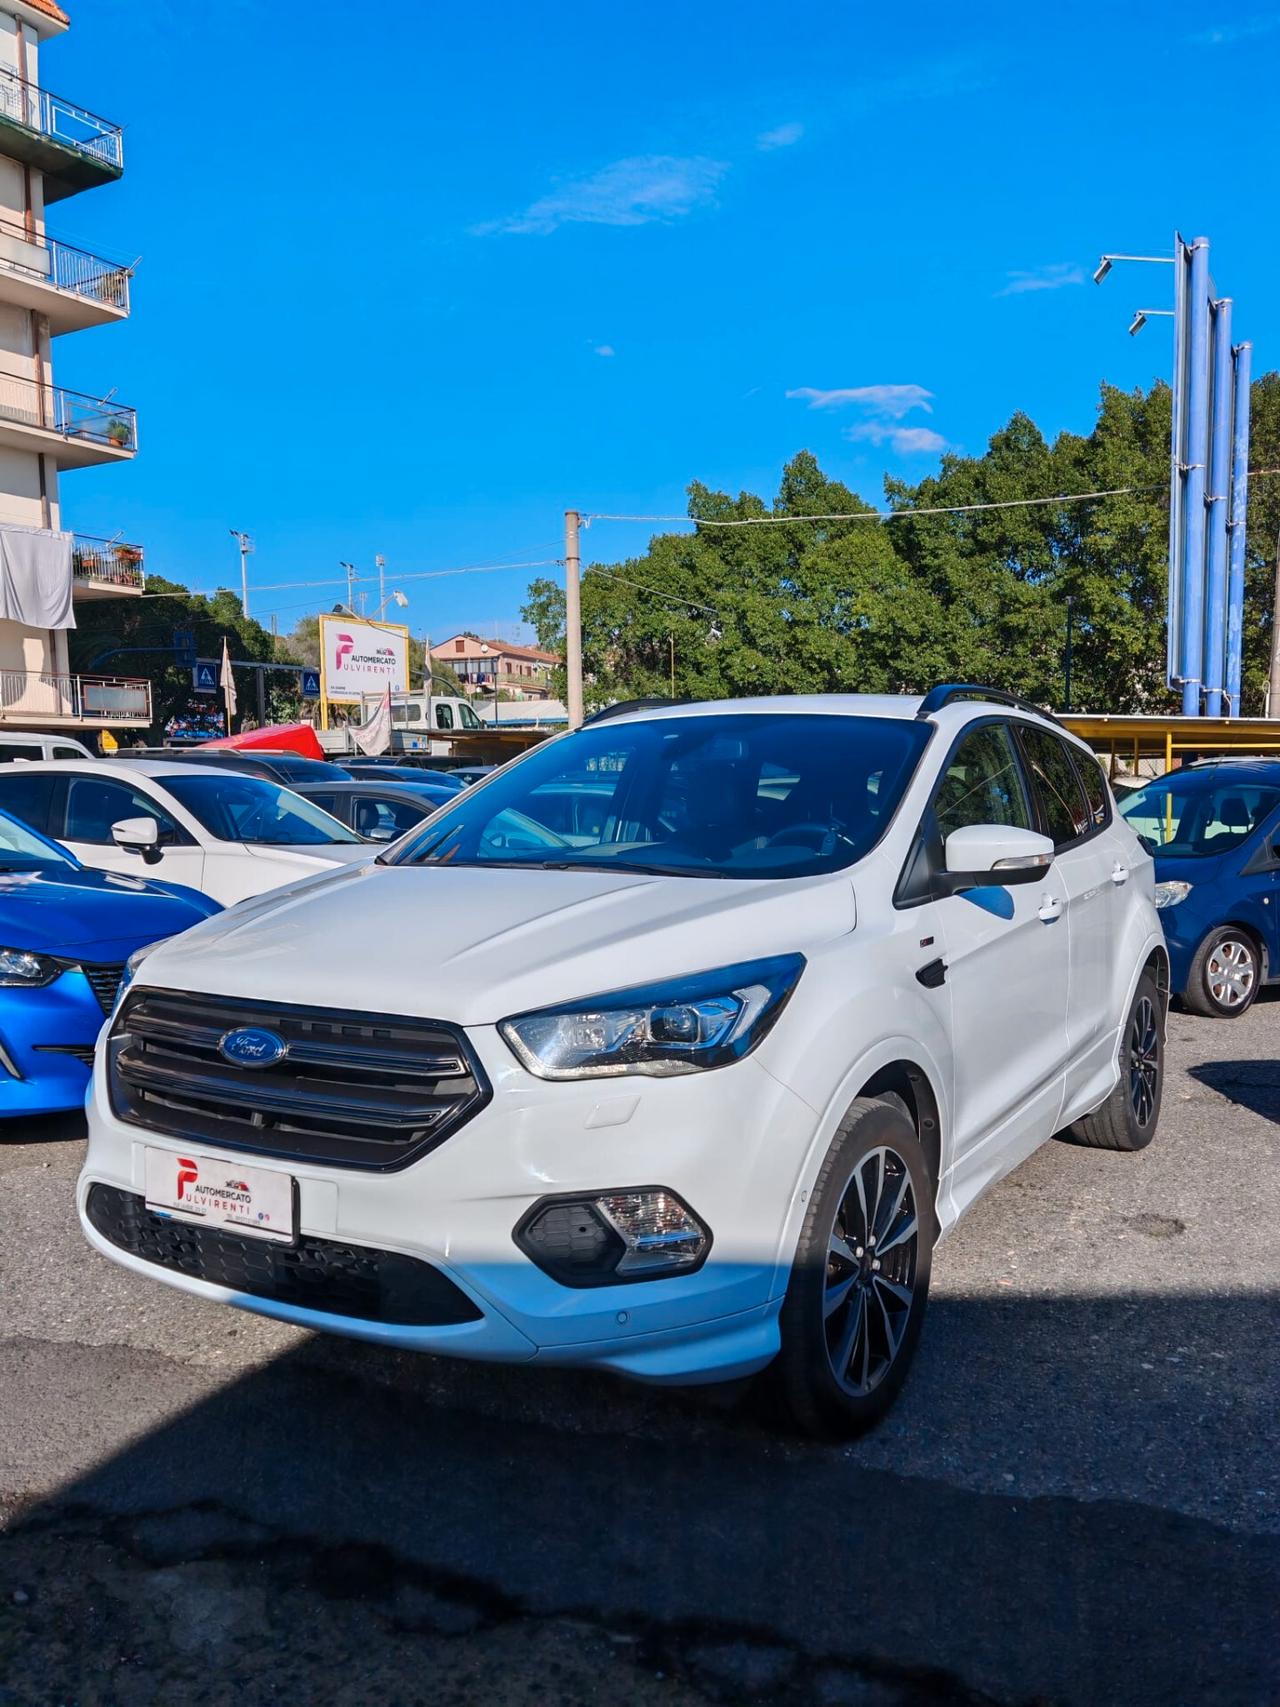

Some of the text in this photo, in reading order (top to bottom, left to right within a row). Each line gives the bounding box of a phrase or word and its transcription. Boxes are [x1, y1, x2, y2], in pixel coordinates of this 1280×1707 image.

[351, 655, 396, 665] AUTOMERCATO
[231, 1036, 267, 1057] Ford
[195, 1184, 252, 1204] AUTOMERCATO
